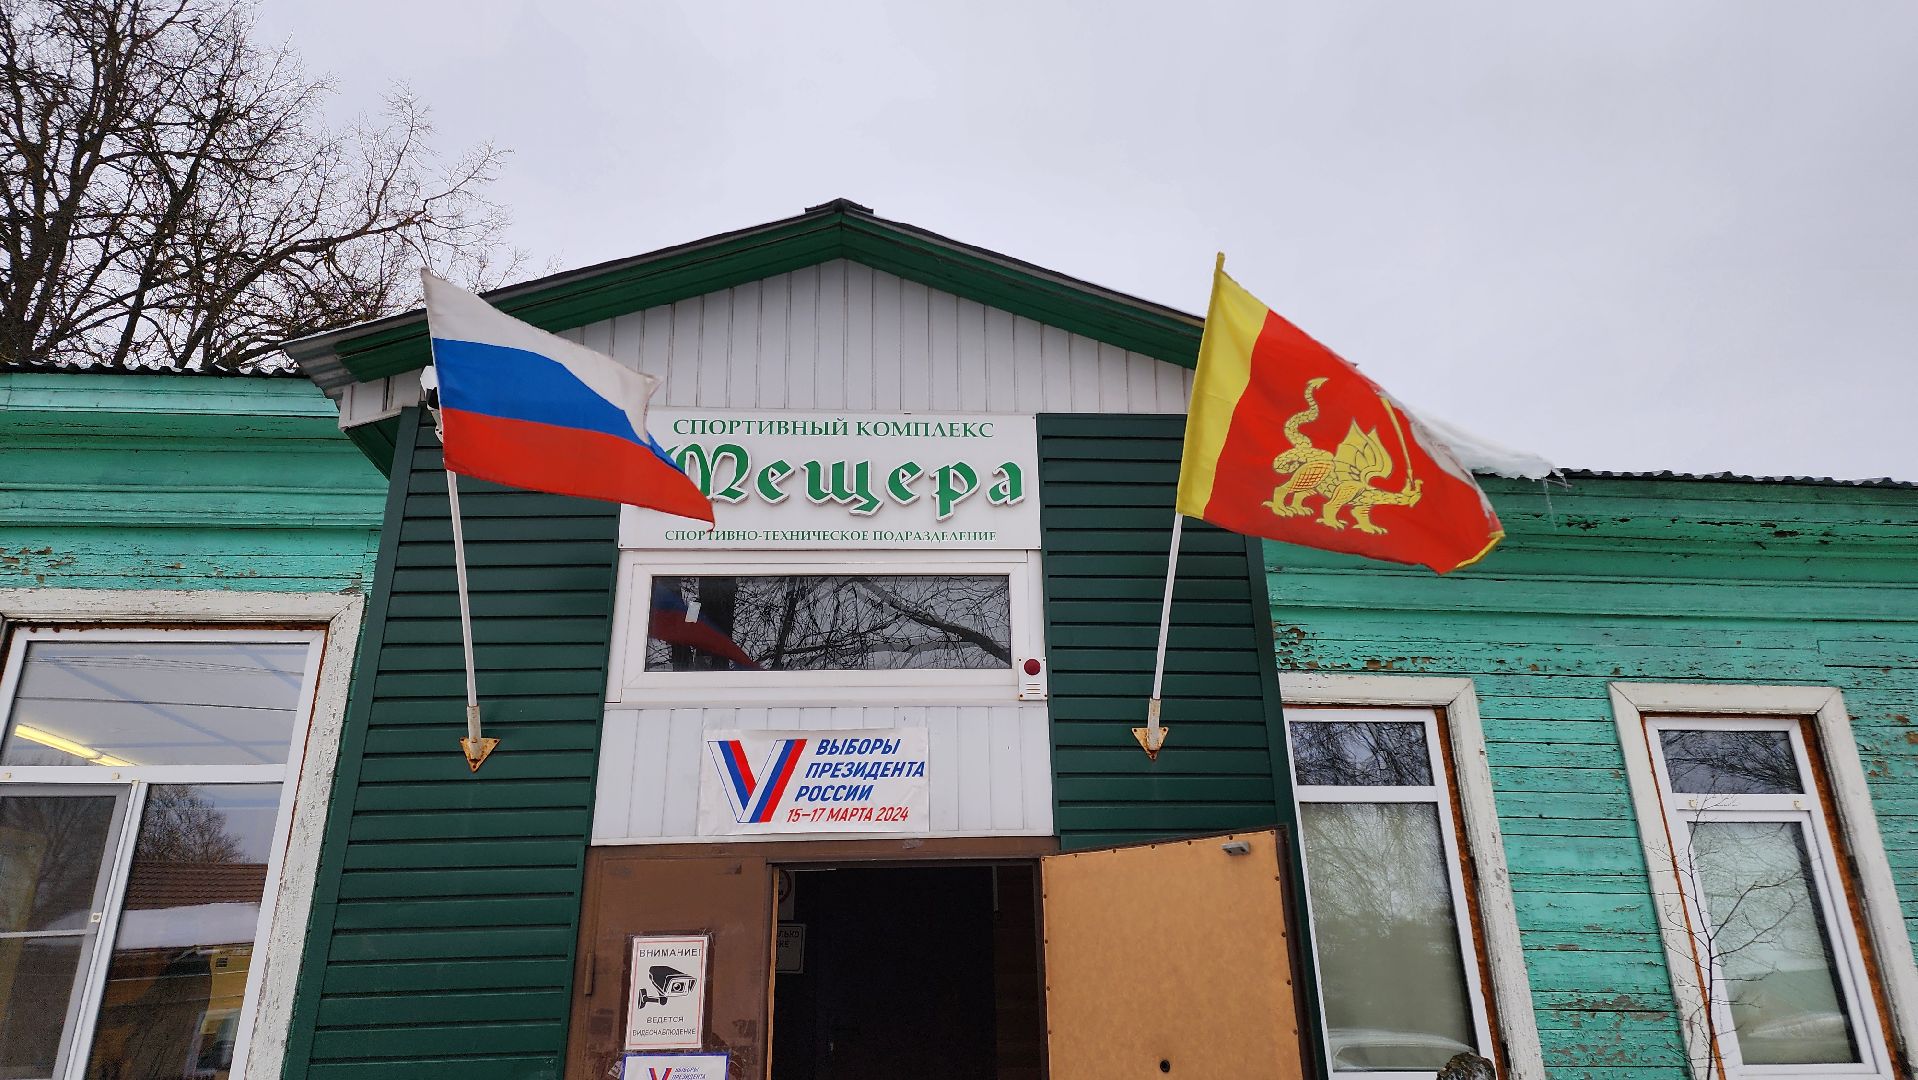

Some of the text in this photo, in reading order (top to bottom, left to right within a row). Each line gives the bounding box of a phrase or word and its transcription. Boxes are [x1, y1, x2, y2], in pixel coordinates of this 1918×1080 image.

[673, 417, 995, 438] СПОРТИВНЫЙ КОМПЛЕКС
[666, 442, 1025, 523] Мещера
[664, 530, 997, 543] СПОРТИВНО-ТЕХНИЧЕСКОЕ ПОДРАЗДЕЛЕНИЕ
[816, 738, 901, 756] ВЫБОРЫ
[805, 761, 926, 781] ПРЕЗИДЕНТА
[794, 784, 874, 802] РОССИИ
[827, 807, 873, 823] МАРТА
[874, 806, 909, 822] 2024
[639, 948, 702, 958] ВНИМАНИЕ!
[646, 1016, 684, 1024] ВЕДЕТСЯ
[632, 1028, 697, 1037] ВИДЕОНАБЛЮДЕНИЕ
